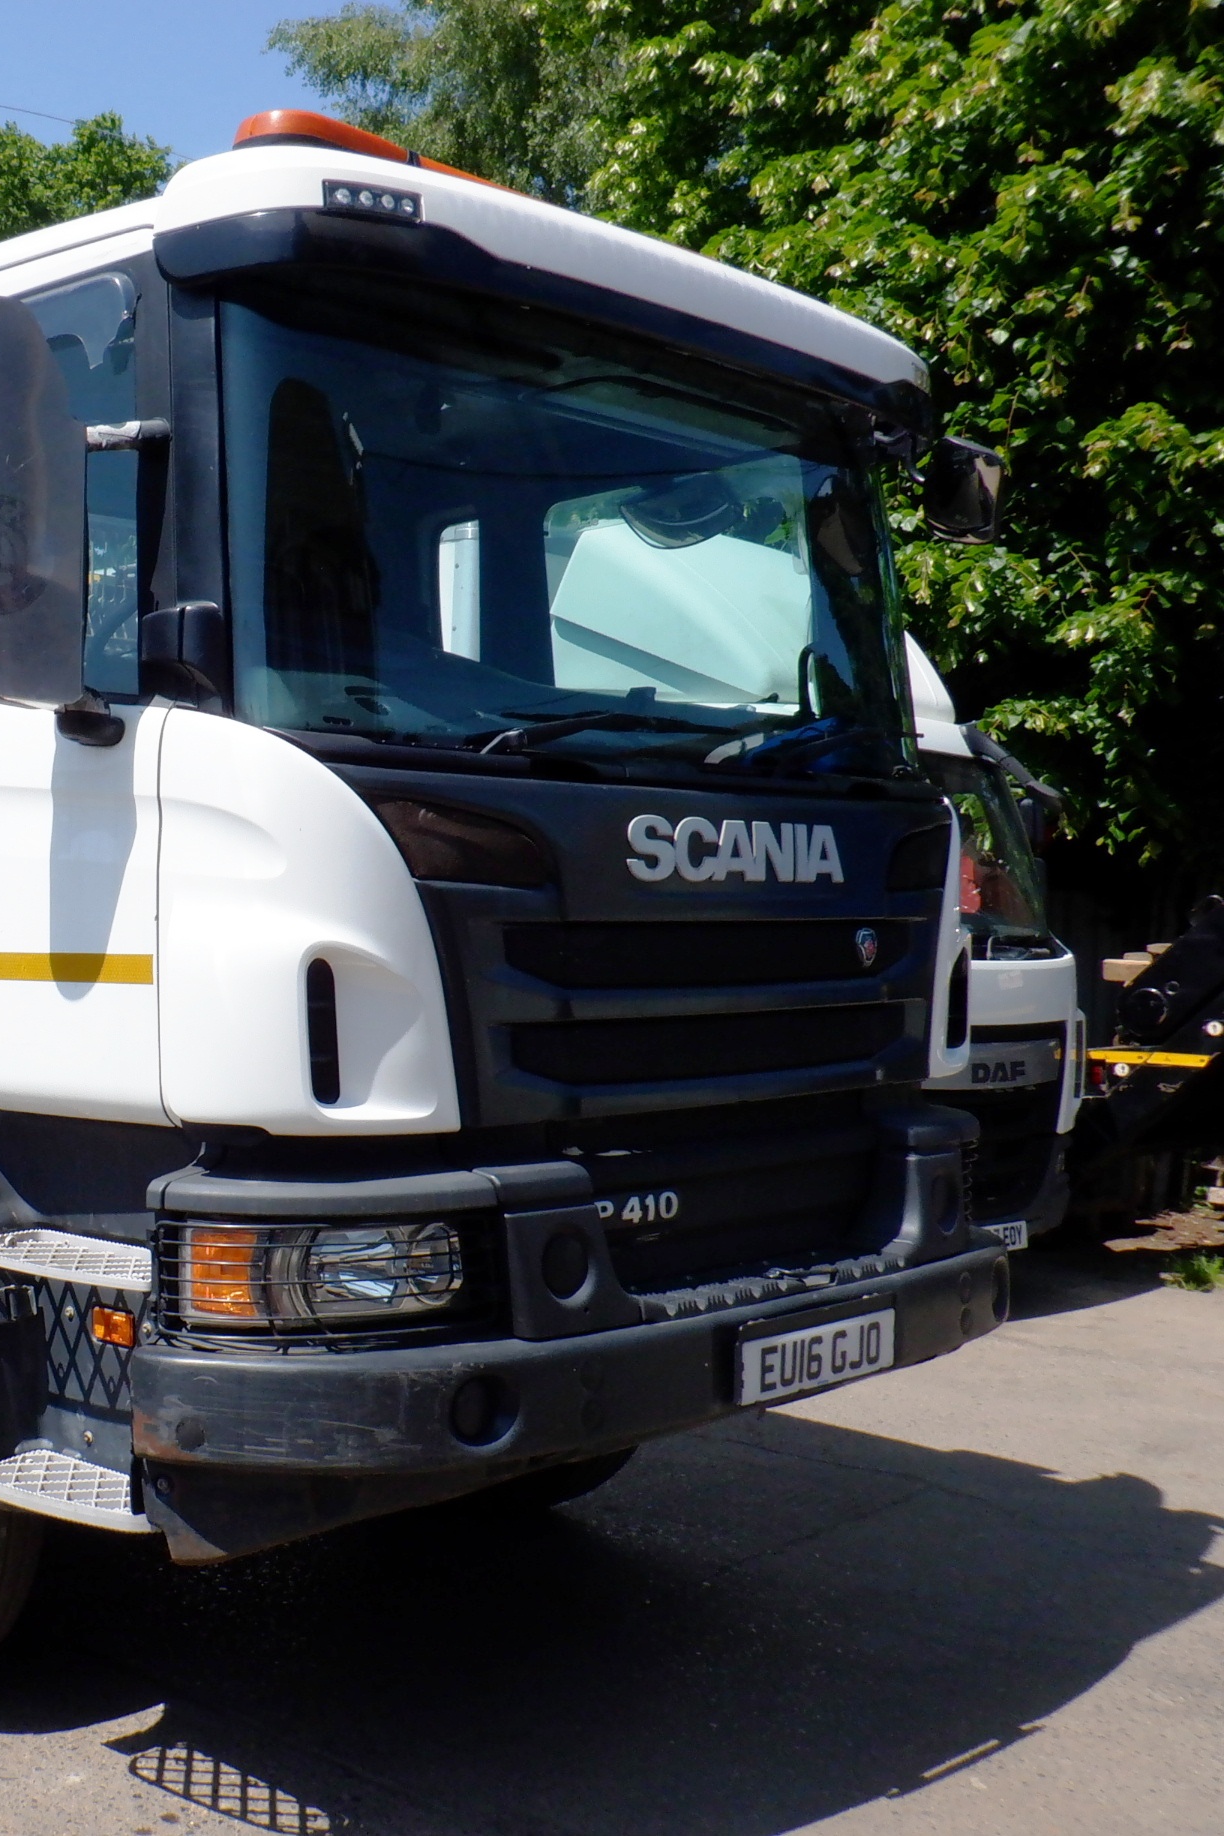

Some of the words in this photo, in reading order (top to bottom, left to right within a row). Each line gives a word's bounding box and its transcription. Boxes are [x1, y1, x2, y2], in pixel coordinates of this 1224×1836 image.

[626, 814, 845, 883] SCANIA
[971, 1061, 1026, 1084] DAF
[621, 1191, 678, 1224] 410
[760, 1335, 823, 1393] EU16
[831, 1321, 880, 1374] GJO
